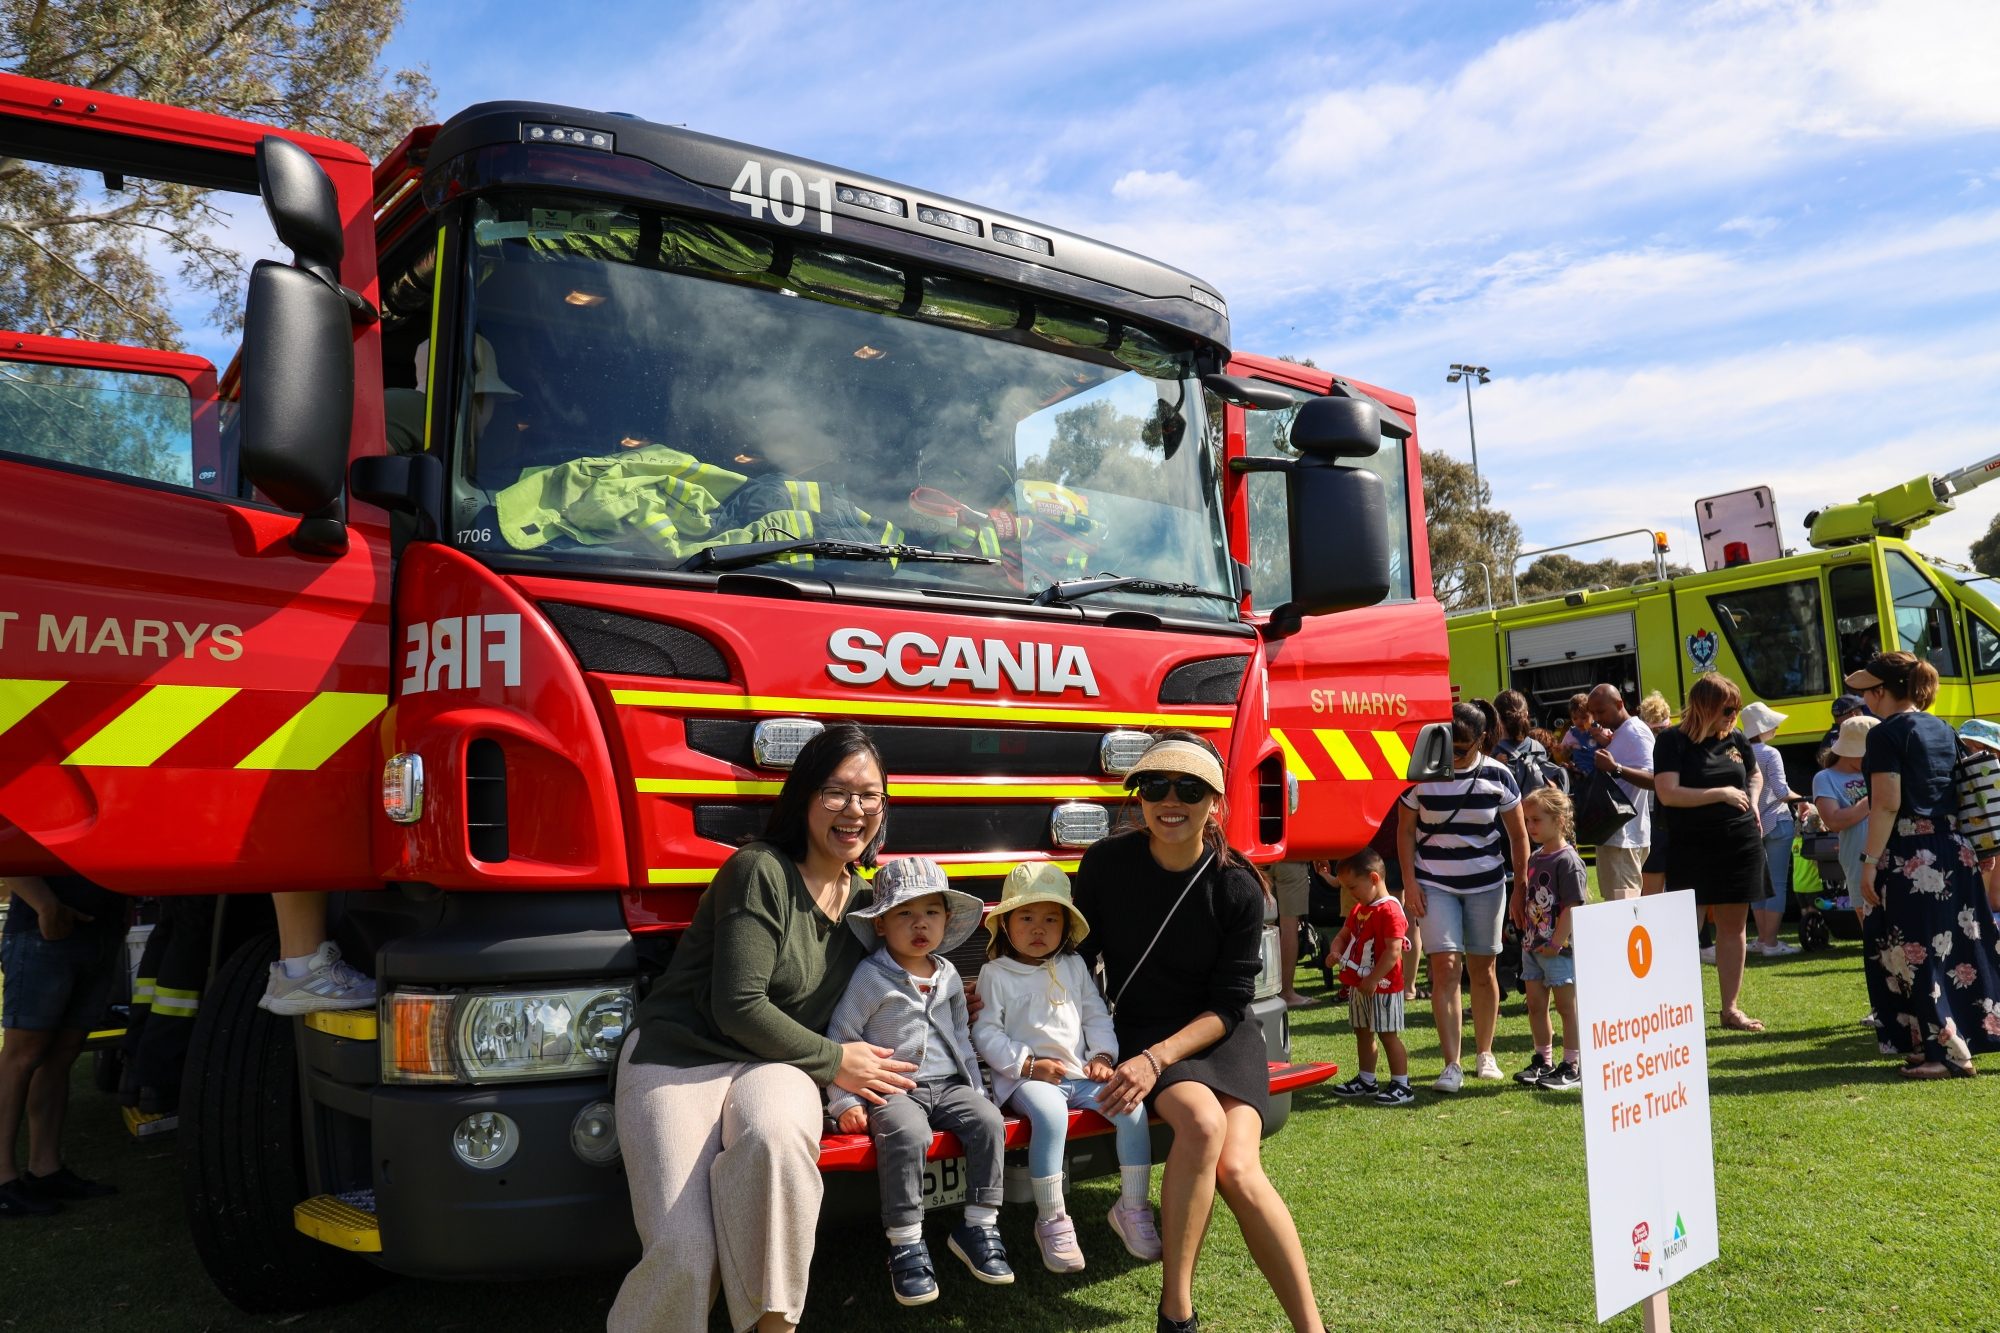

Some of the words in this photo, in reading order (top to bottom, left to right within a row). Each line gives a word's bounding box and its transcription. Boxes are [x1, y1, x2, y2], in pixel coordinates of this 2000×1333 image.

[730, 160, 834, 234] 401
[457, 528, 491, 544] 1706
[37, 613, 244, 662] MARYS
[826, 628, 1100, 697] SCANIA
[1310, 689, 1336, 714] ST
[1341, 690, 1408, 717] MARYS
[1634, 938, 1645, 965] 1
[1592, 1003, 1694, 1050] Metropolitan
[1602, 1060, 1633, 1091] Fire
[1636, 1043, 1690, 1080] Service
[1611, 1101, 1642, 1133] Fire
[1644, 1081, 1688, 1119] Truck
[932, 1194, 946, 1206] SA
[1663, 1236, 1688, 1261] MARION
